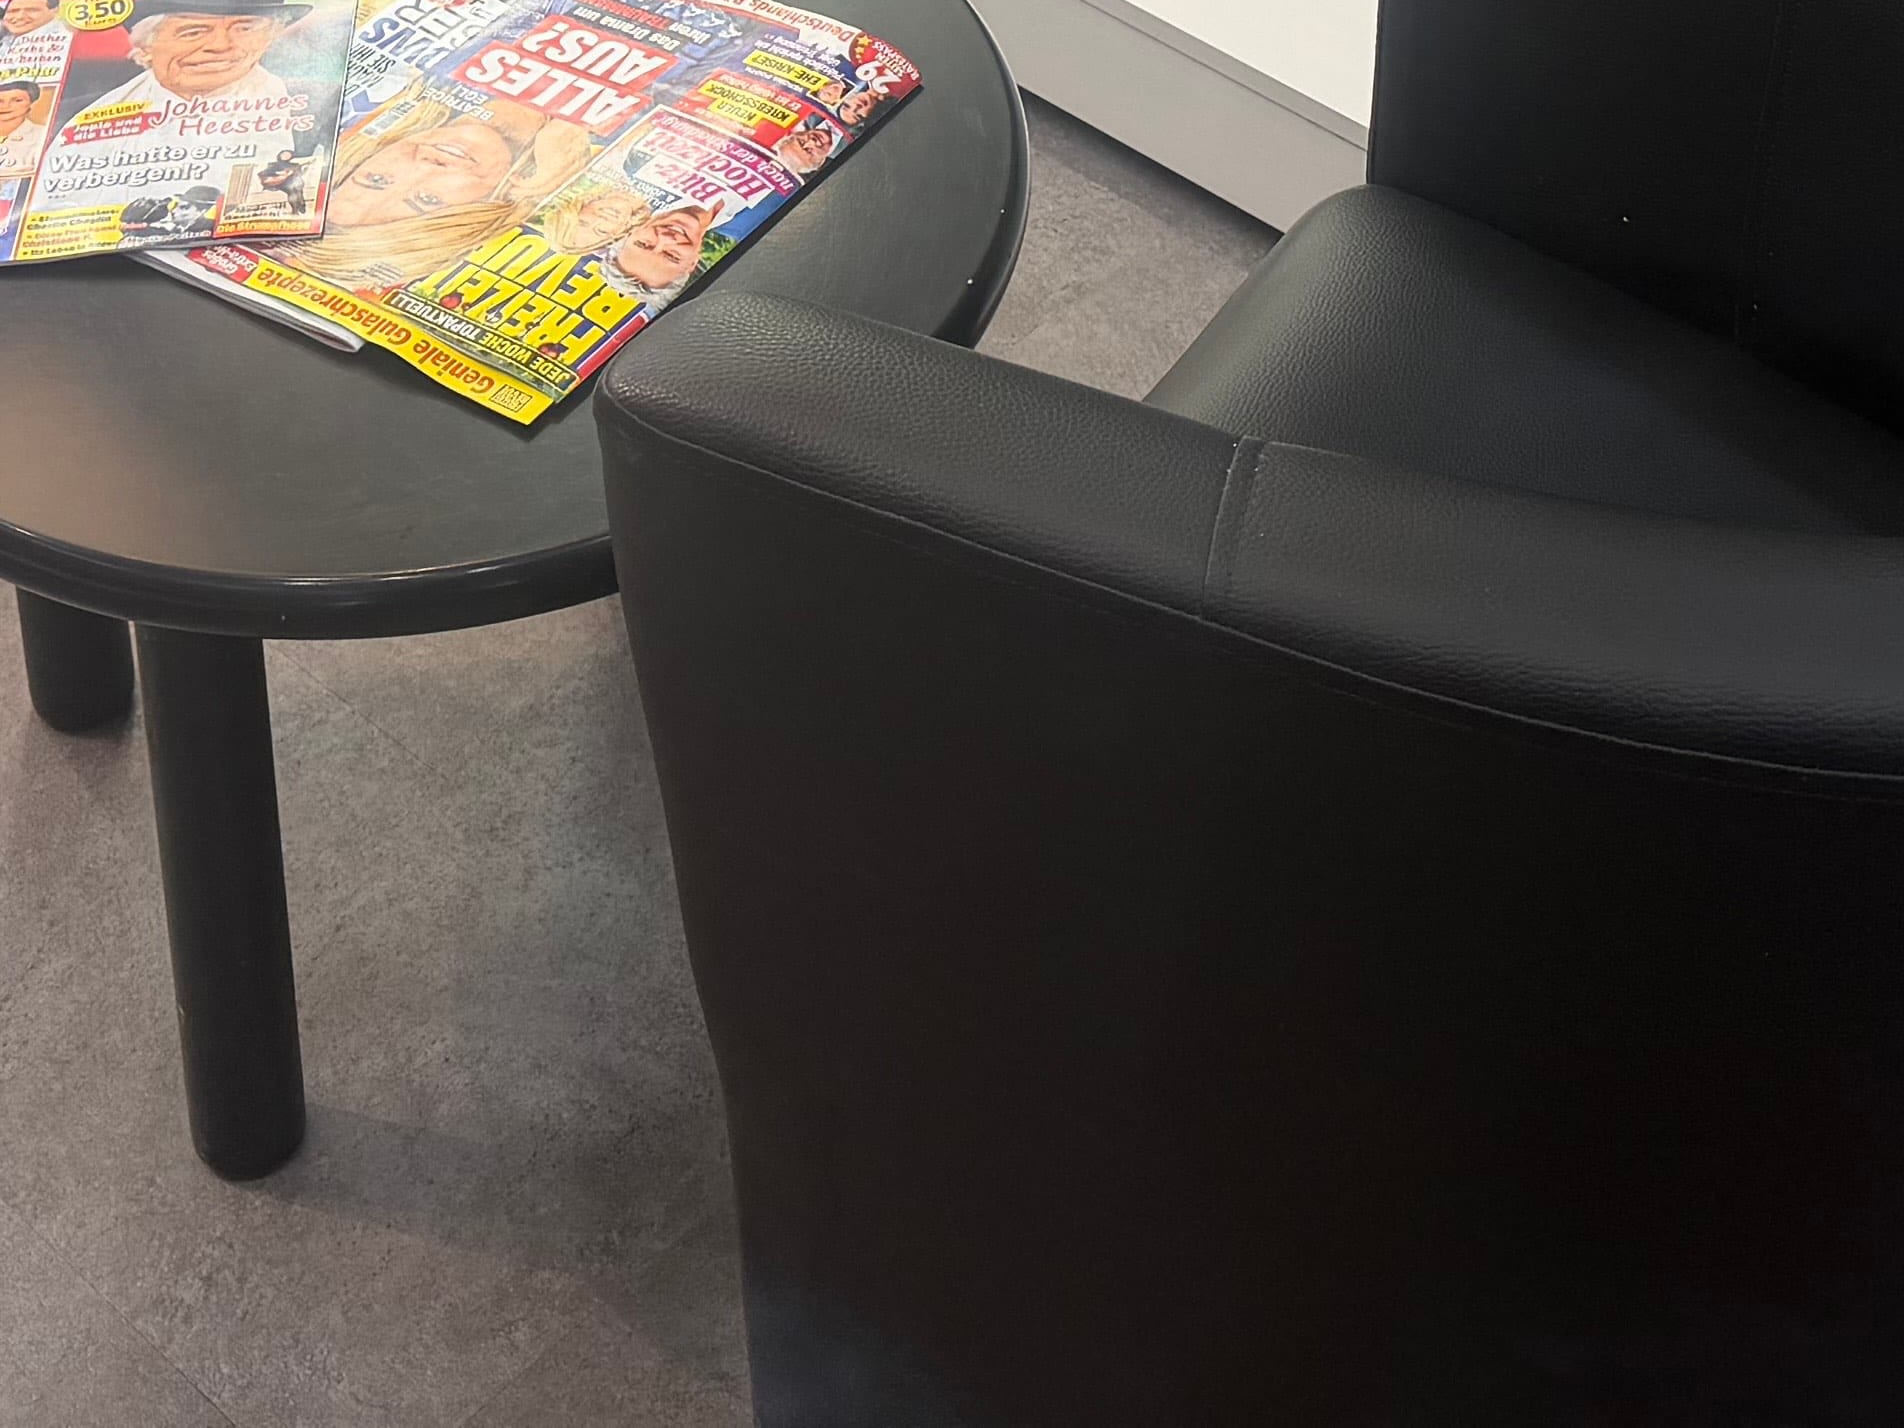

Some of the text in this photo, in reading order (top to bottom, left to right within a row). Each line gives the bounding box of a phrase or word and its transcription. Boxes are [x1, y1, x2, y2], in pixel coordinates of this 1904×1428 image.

[75, 0, 126, 21] 3,50
[527, 20, 666, 80] AUS?
[464, 51, 641, 126] ALLES
[152, 95, 308, 126] Johannes
[180, 115, 314, 136] Heesters
[51, 145, 255, 173] Was hatte er zu
[257, 266, 492, 396] Geniale Gulaschrezepte
[481, 329, 531, 363] WOCHE
[533, 355, 571, 384] JEDE
